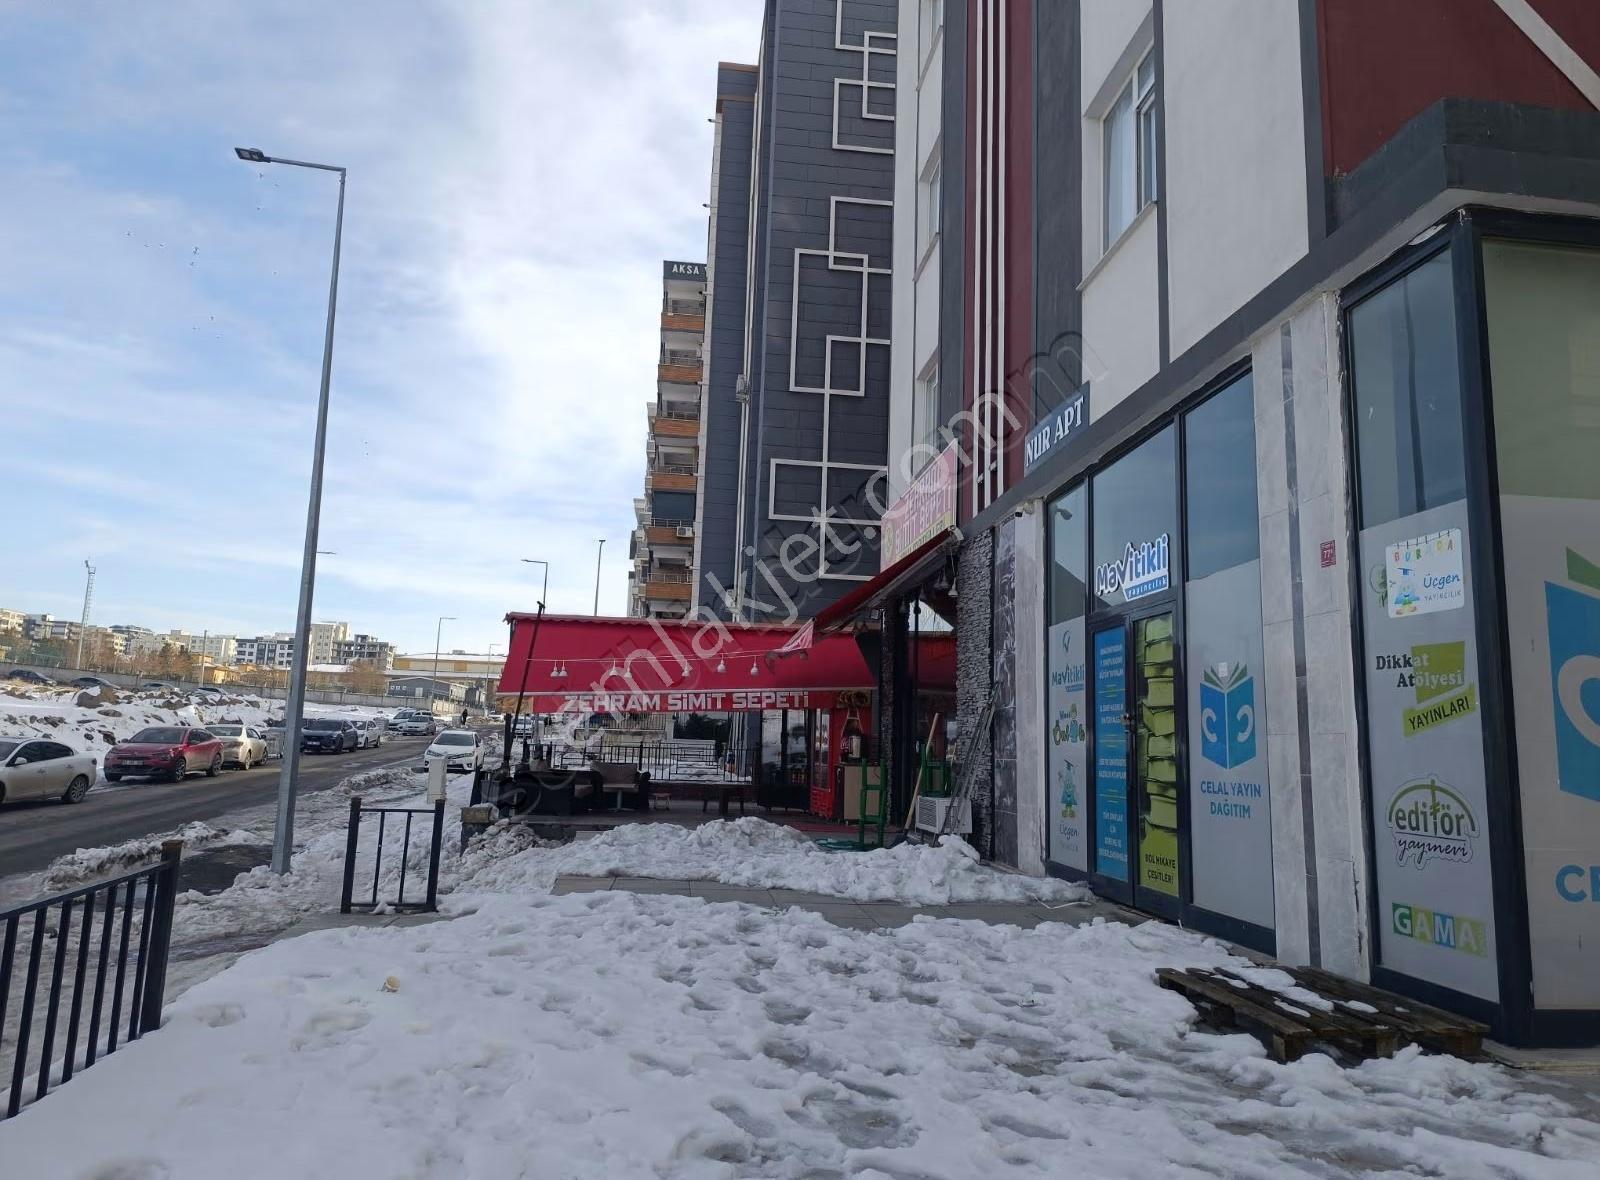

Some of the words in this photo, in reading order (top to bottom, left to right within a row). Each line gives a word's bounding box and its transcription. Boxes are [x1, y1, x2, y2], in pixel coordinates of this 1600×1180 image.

[672, 264, 700, 275] AKSA
[1026, 426, 1051, 467] NUR
[1054, 395, 1084, 444] APT
[1375, 653, 1430, 670] Dikkat
[1397, 669, 1464, 690] Atölyesi
[564, 694, 661, 712] ZEHRAM
[1408, 695, 1470, 731] YAYINLARI
[1200, 780, 1229, 796] CELAL
[1230, 782, 1262, 799] YAYIN
[1209, 798, 1251, 819] DAĞITIM
[1394, 792, 1465, 838] editör
[1393, 905, 1478, 951] GAMA
